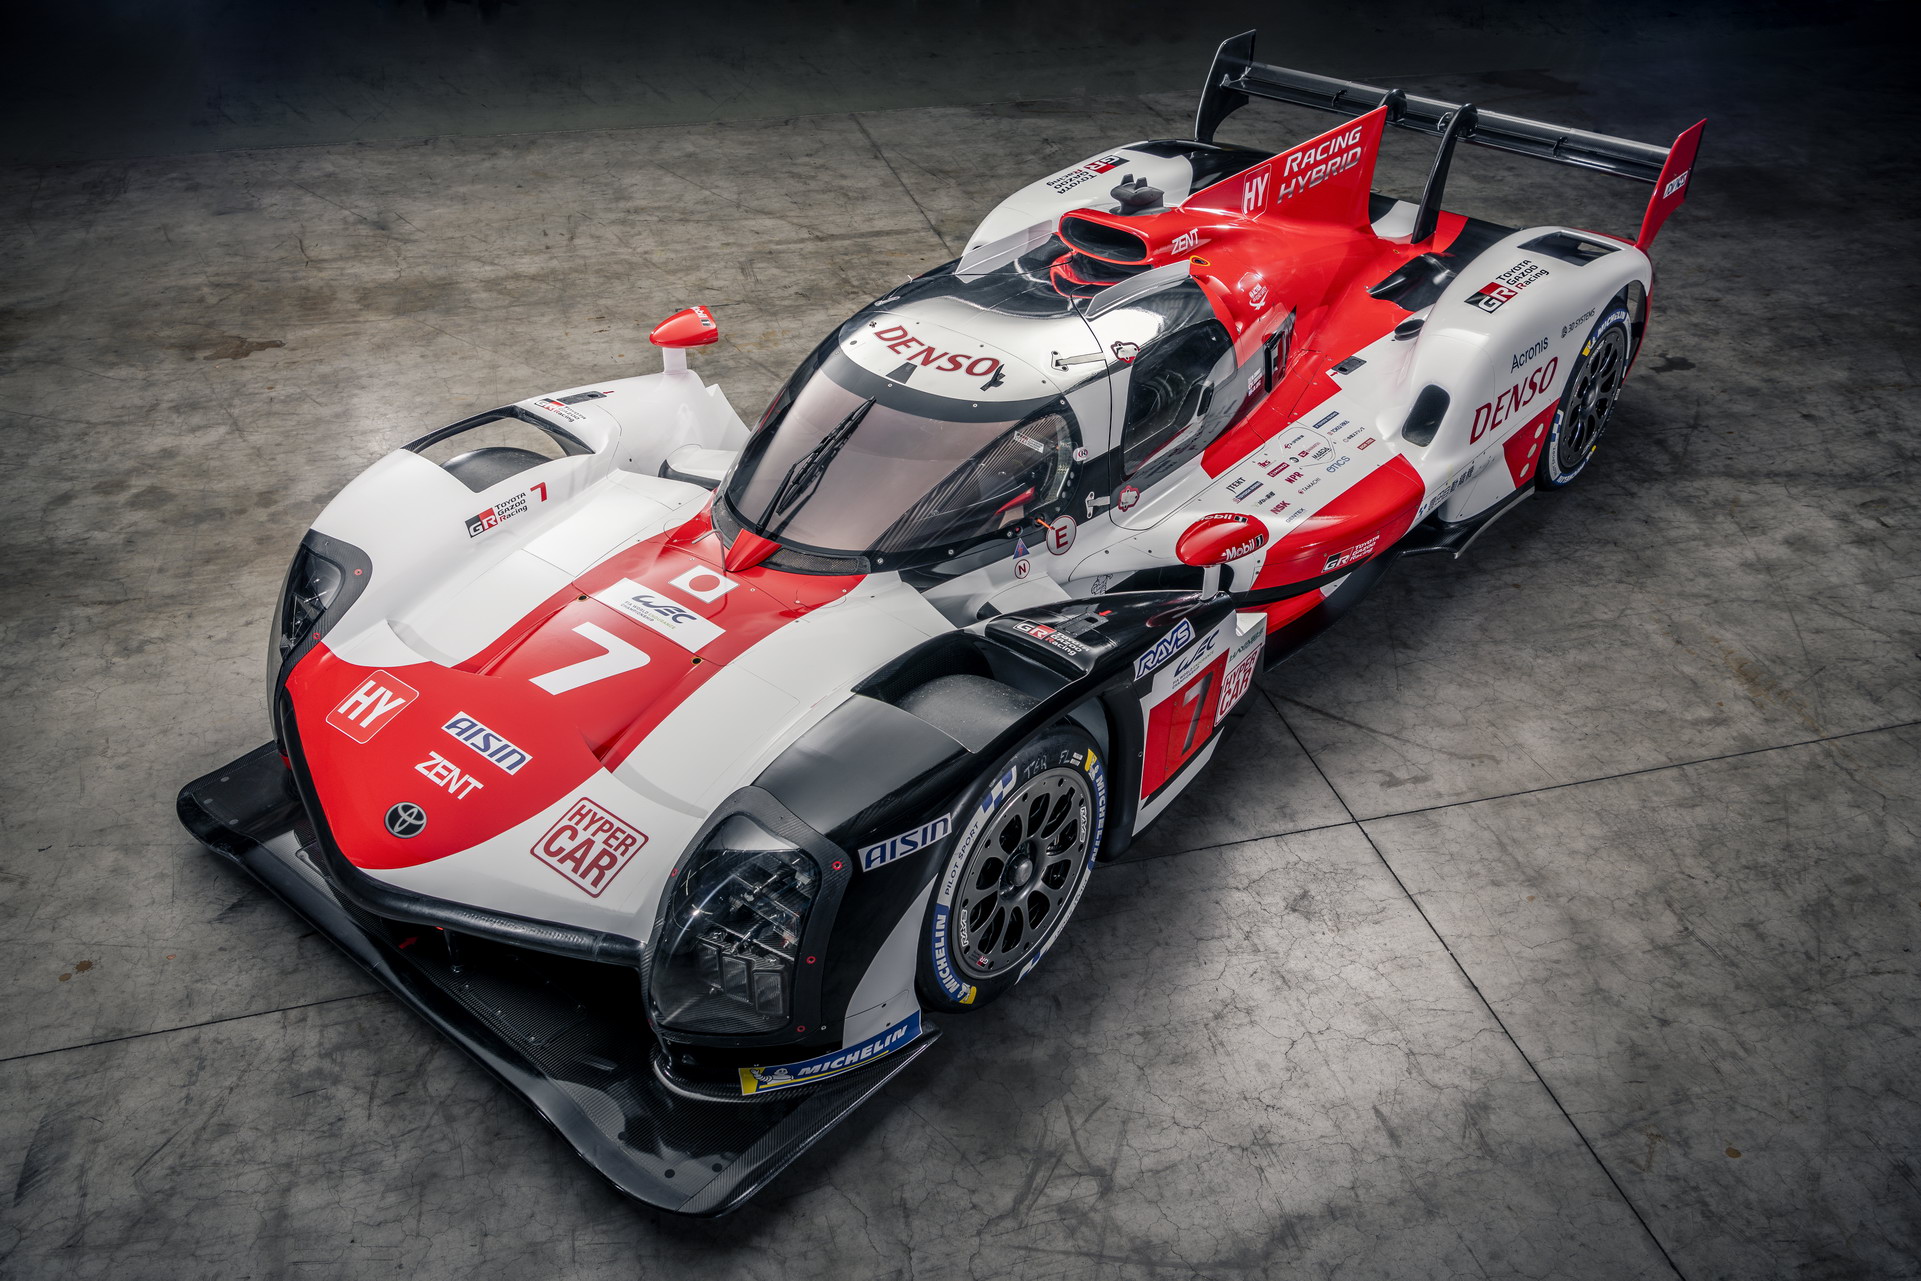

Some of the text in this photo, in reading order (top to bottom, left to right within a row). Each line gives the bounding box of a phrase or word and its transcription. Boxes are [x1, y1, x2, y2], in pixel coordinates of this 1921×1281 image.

[1283, 126, 1363, 177] RACING
[1277, 146, 1362, 205] HYBRID
[1242, 172, 1269, 214] HY
[1171, 228, 1199, 255] ZENT
[1496, 259, 1532, 282] TOYOTA
[1506, 264, 1539, 286] GAZOO
[1515, 268, 1550, 291] Racing
[1478, 286, 1517, 312] GR
[1575, 308, 1596, 329] SYSTEMS
[873, 325, 1001, 377] DENSO
[1510, 336, 1549, 374] Acronis
[1469, 356, 1559, 445] DENSO
[530, 482, 547, 502] 7
[1226, 477, 1247, 494] JTEKT
[1284, 471, 1304, 485] NPR
[494, 492, 527, 511] TOYOTA
[497, 498, 527, 516] GAZOO
[500, 505, 528, 523] Racing
[1270, 500, 1292, 515] NSK
[469, 514, 498, 537] GR
[1055, 525, 1069, 550] E
[1225, 538, 1255, 561] Mobil
[1324, 554, 1350, 571] GR
[1018, 563, 1027, 575] N
[632, 594, 698, 624] WEC
[1016, 623, 1049, 638] GR
[1050, 634, 1082, 653] GAZOO
[1057, 631, 1090, 652] TOYOTA
[528, 621, 651, 696] 7
[1045, 637, 1077, 657] Racing
[1136, 620, 1192, 678] RAYS
[1174, 629, 1220, 677] WEC
[1224, 650, 1258, 694] HYPER
[337, 680, 406, 728] HY
[1219, 667, 1251, 716] CAR
[1181, 671, 1214, 757] 7
[444, 716, 528, 772] AISIN
[414, 750, 485, 800] ZENT
[567, 803, 638, 857] HYPER
[1091, 774, 1106, 863] MICHELIN
[542, 823, 619, 889] CAR
[864, 817, 950, 870] AISIN
[945, 820, 980, 896] PILOT SPORT
[935, 914, 961, 994] MICHELIN
[797, 1024, 909, 1077] MICHELIN
